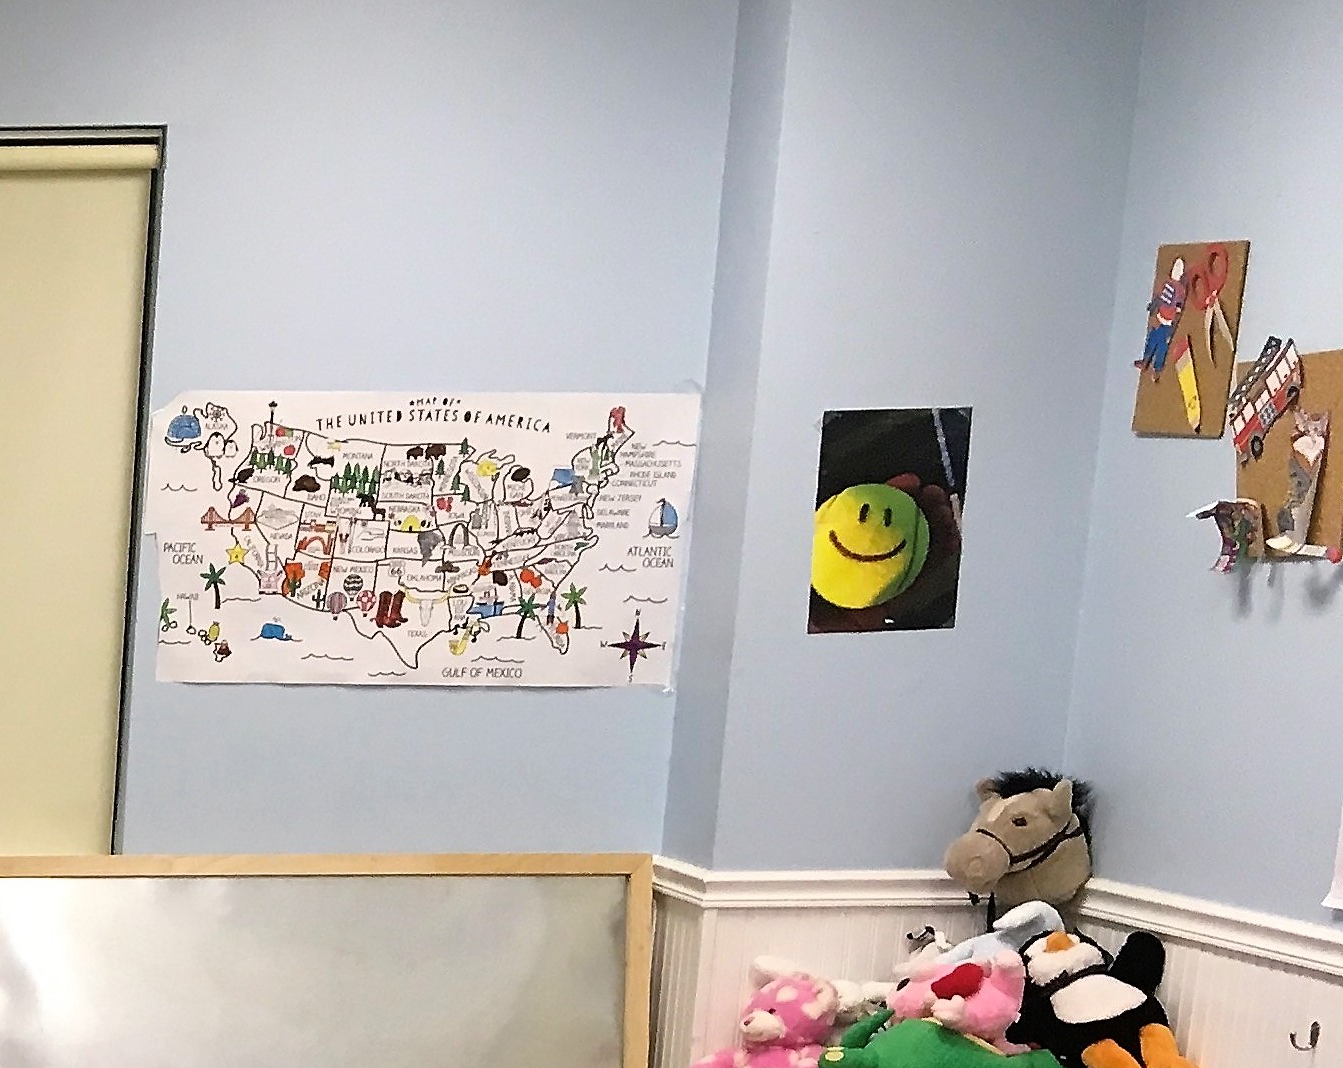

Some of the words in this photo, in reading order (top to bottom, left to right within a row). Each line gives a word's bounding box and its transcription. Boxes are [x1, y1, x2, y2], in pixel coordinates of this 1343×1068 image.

[417, 397, 437, 406] MAP
[316, 415, 342, 431] THE
[348, 409, 402, 426] UNITED
[409, 408, 458, 422] STATES
[464, 410, 482, 424] OF
[485, 413, 550, 433] AMERICA
[566, 432, 596, 440] VERMONT
[625, 460, 682, 468] MASSACHUSETTS
[253, 475, 281, 483] OREGON
[654, 471, 677, 479] ISLAND
[405, 492, 430, 500] DAKOTA
[598, 494, 614, 502] NEW
[617, 494, 642, 502] JERSEY
[597, 508, 630, 516] DELAWARE
[163, 542, 196, 553] PACIFIC
[353, 546, 384, 554] COLORADO
[627, 546, 672, 557] ATLANTIC
[172, 554, 204, 565] OCEAN
[642, 558, 674, 568] OCEAN
[390, 567, 402, 575] 66
[407, 630, 429, 638] TEXAS
[442, 667, 467, 678] GULF
[470, 667, 483, 678] OF
[486, 667, 522, 678] MEXICO
[628, 675, 633, 683] S
